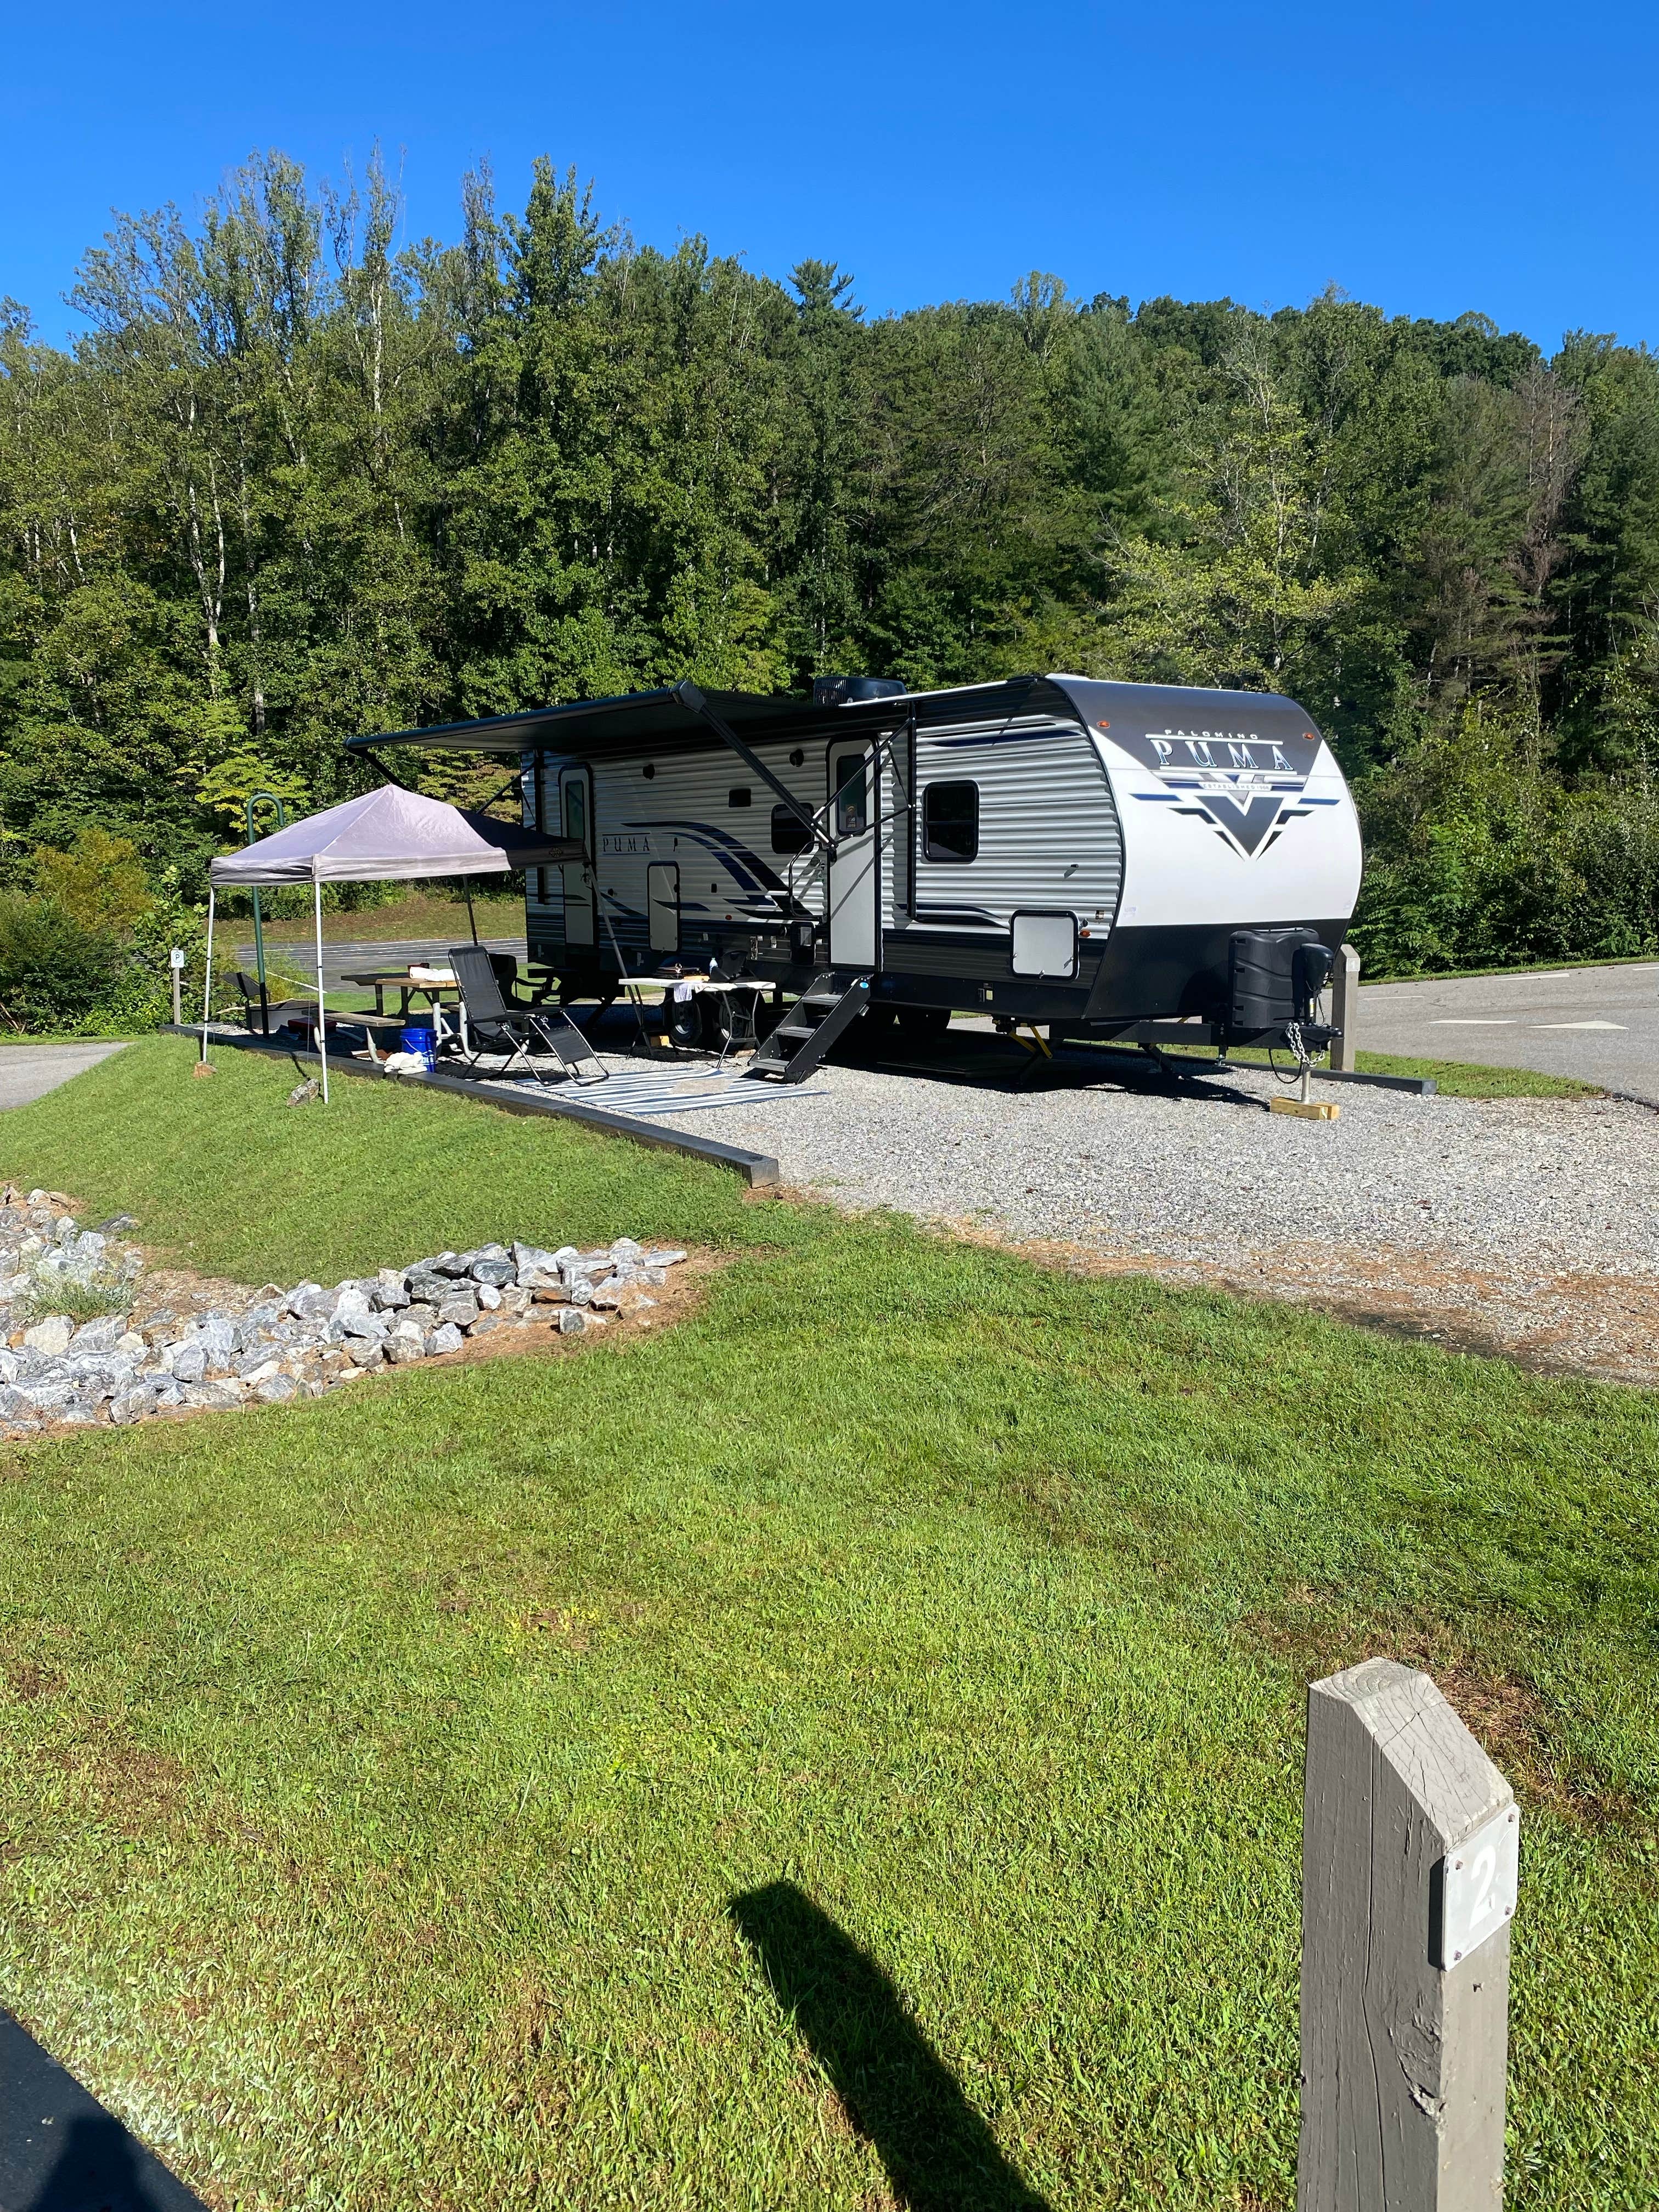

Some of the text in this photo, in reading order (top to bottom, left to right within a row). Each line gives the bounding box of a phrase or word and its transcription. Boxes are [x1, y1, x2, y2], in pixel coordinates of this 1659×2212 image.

[1164, 729, 1259, 740] PALOMINO
[1150, 738, 1294, 770] PUMA
[602, 836, 651, 852] PUMA
[1468, 1844, 1497, 1931] 2
